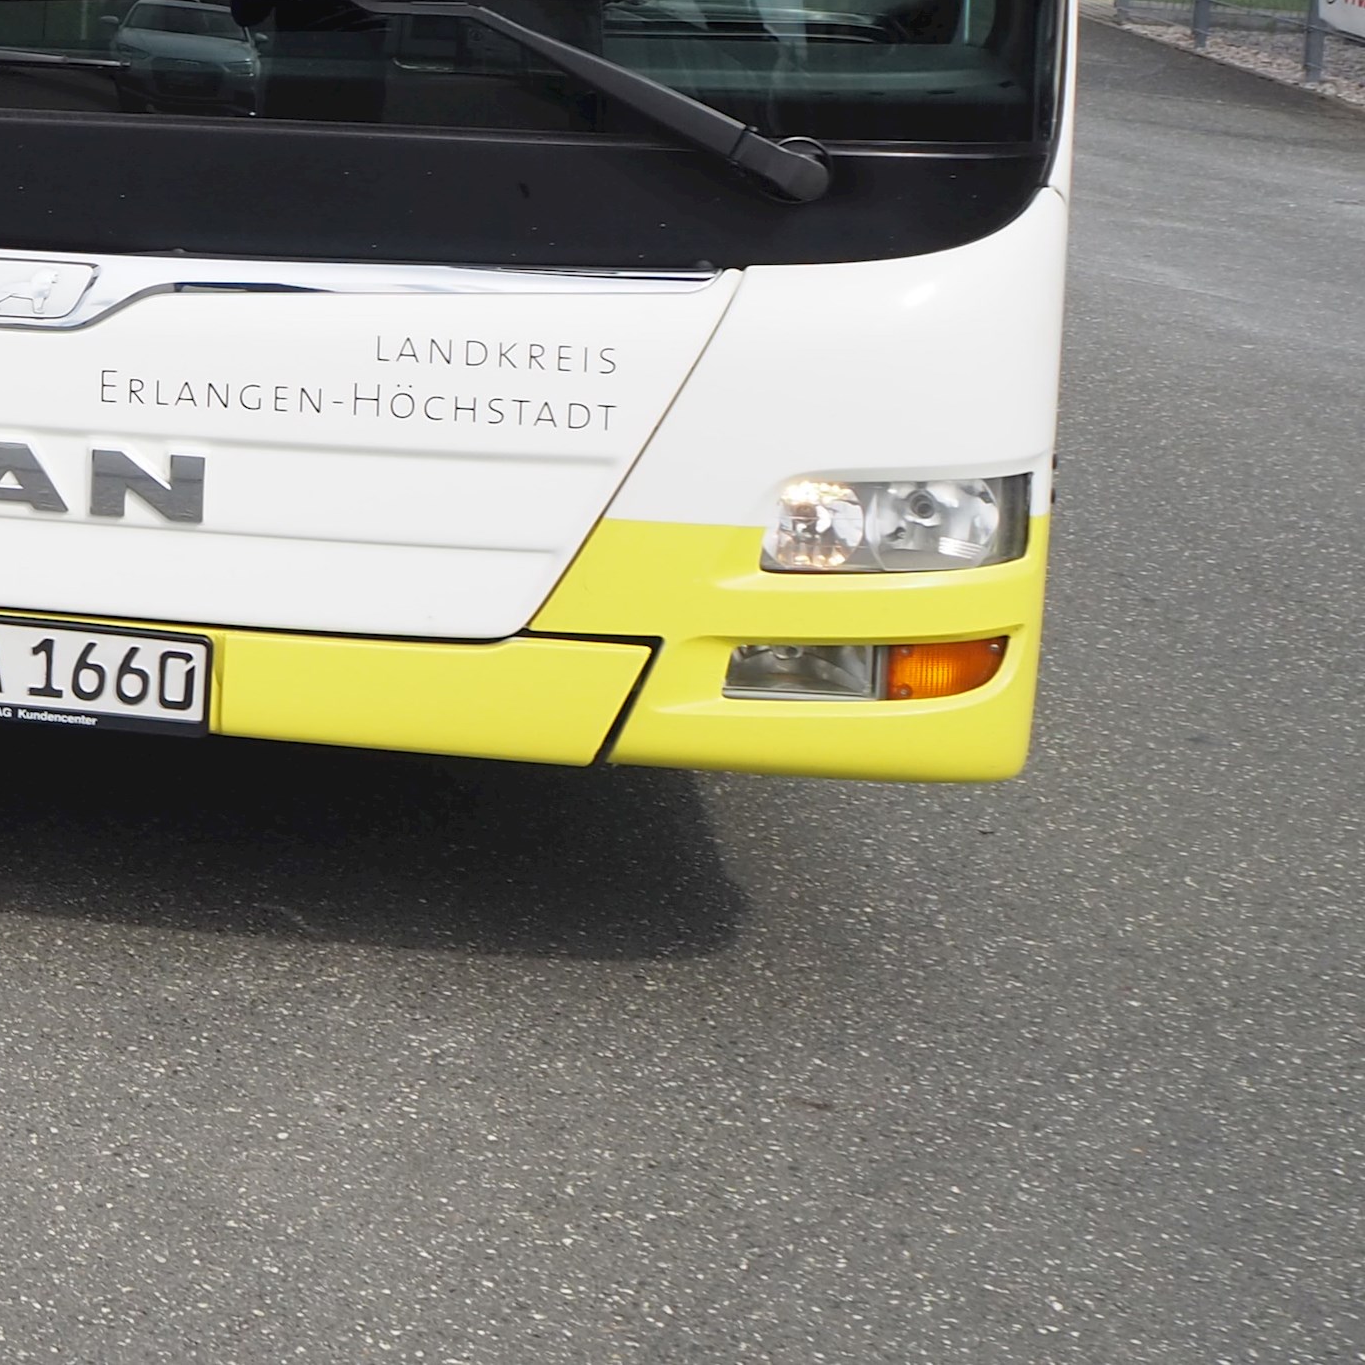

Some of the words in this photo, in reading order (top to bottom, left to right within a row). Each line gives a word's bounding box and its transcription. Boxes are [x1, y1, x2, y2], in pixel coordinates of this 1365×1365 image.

[375, 334, 618, 375] LANDKREIS
[99, 368, 618, 432] ERLANGEN-HÖCHSTADT
[27, 637, 196, 711] 1660
[17, 708, 98, 726] Kundencenter
